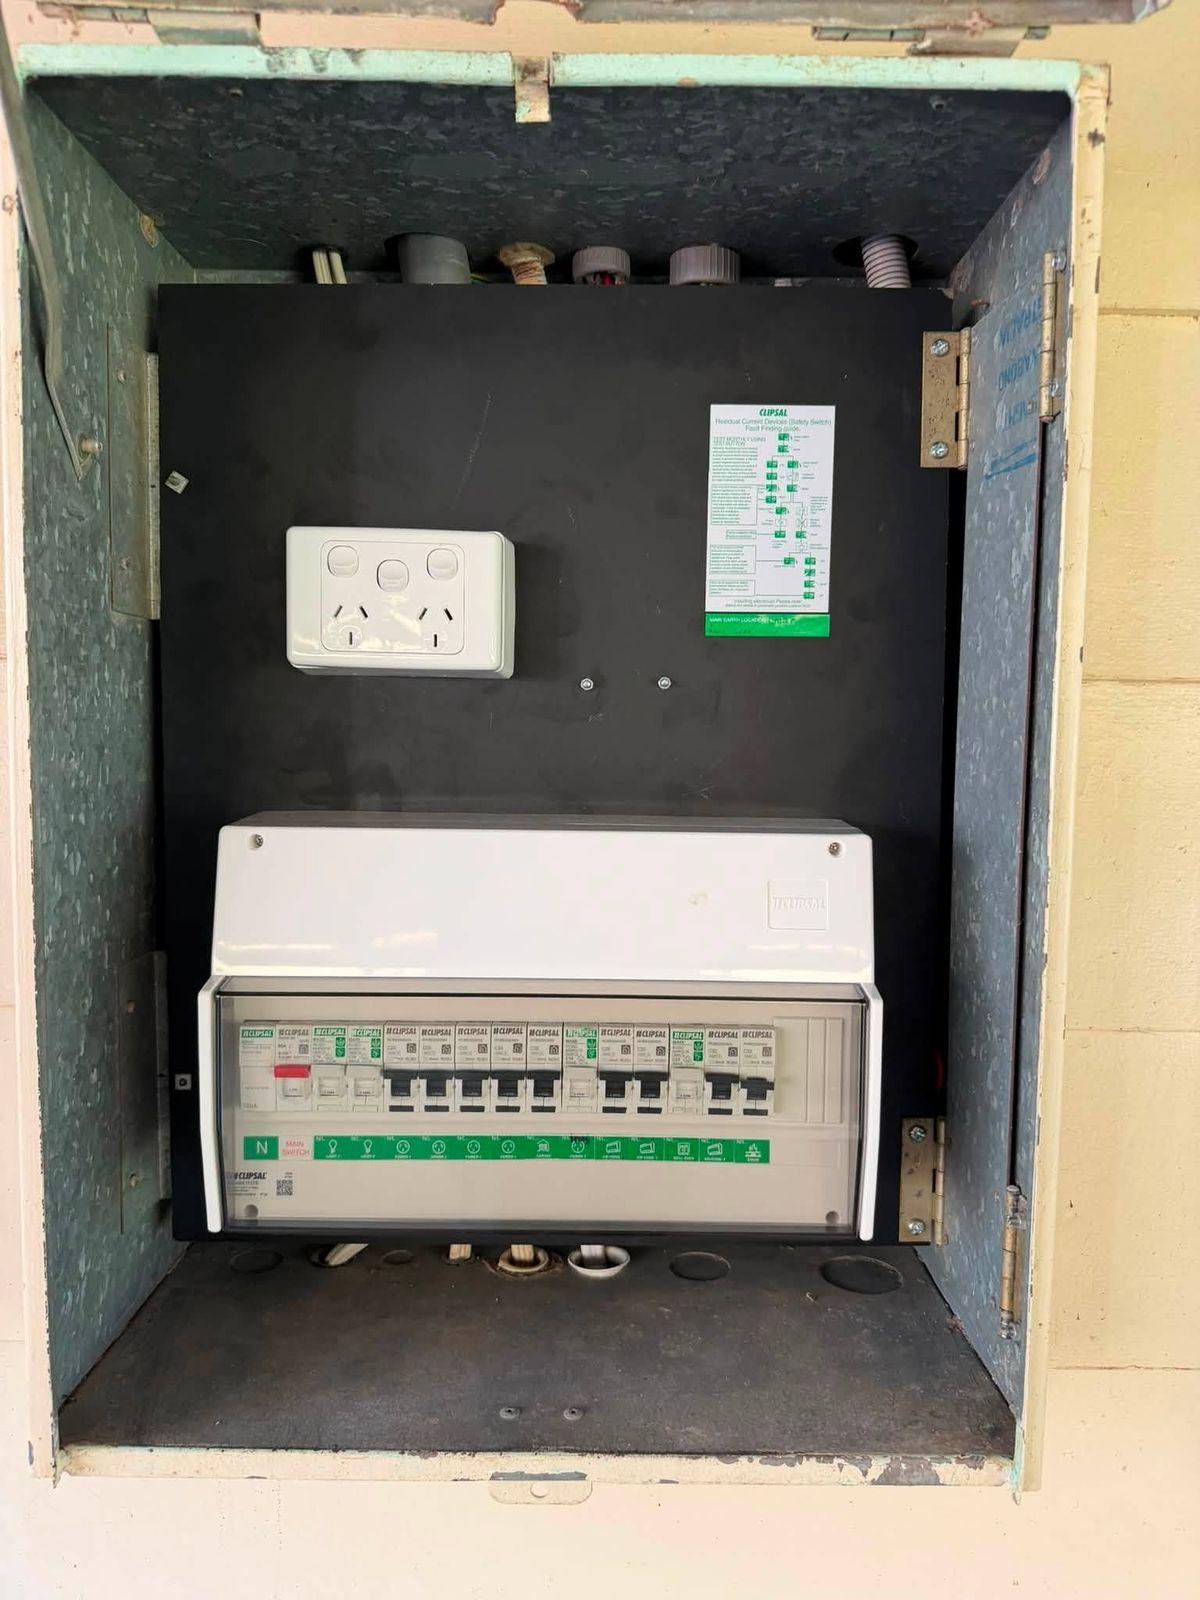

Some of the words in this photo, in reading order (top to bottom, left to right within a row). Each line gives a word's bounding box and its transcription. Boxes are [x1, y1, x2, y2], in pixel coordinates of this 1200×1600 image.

[759, 408, 788, 417] CLIPSAL
[761, 425, 781, 433] Finding
[248, 1030, 273, 1038] CLIPSAL
[283, 1028, 309, 1036] CLIPSAL
[322, 1028, 345, 1036] CLIPSAL
[427, 1028, 452, 1036] CLIPSAL
[464, 1028, 488, 1036] CLIPSAL
[535, 1028, 559, 1037] CLIPSAL
[607, 1029, 631, 1037] CLIPSAL
[642, 1030, 666, 1038] CLIPSAL
[679, 1032, 703, 1040] CLIPSAL
[714, 1031, 738, 1039] CLIPSAL
[749, 1031, 773, 1039] CLIPSAL
[256, 1141, 268, 1154] N
[282, 1148, 310, 1156] SWITCH
[238, 1172, 267, 1180] CLIPSAL
